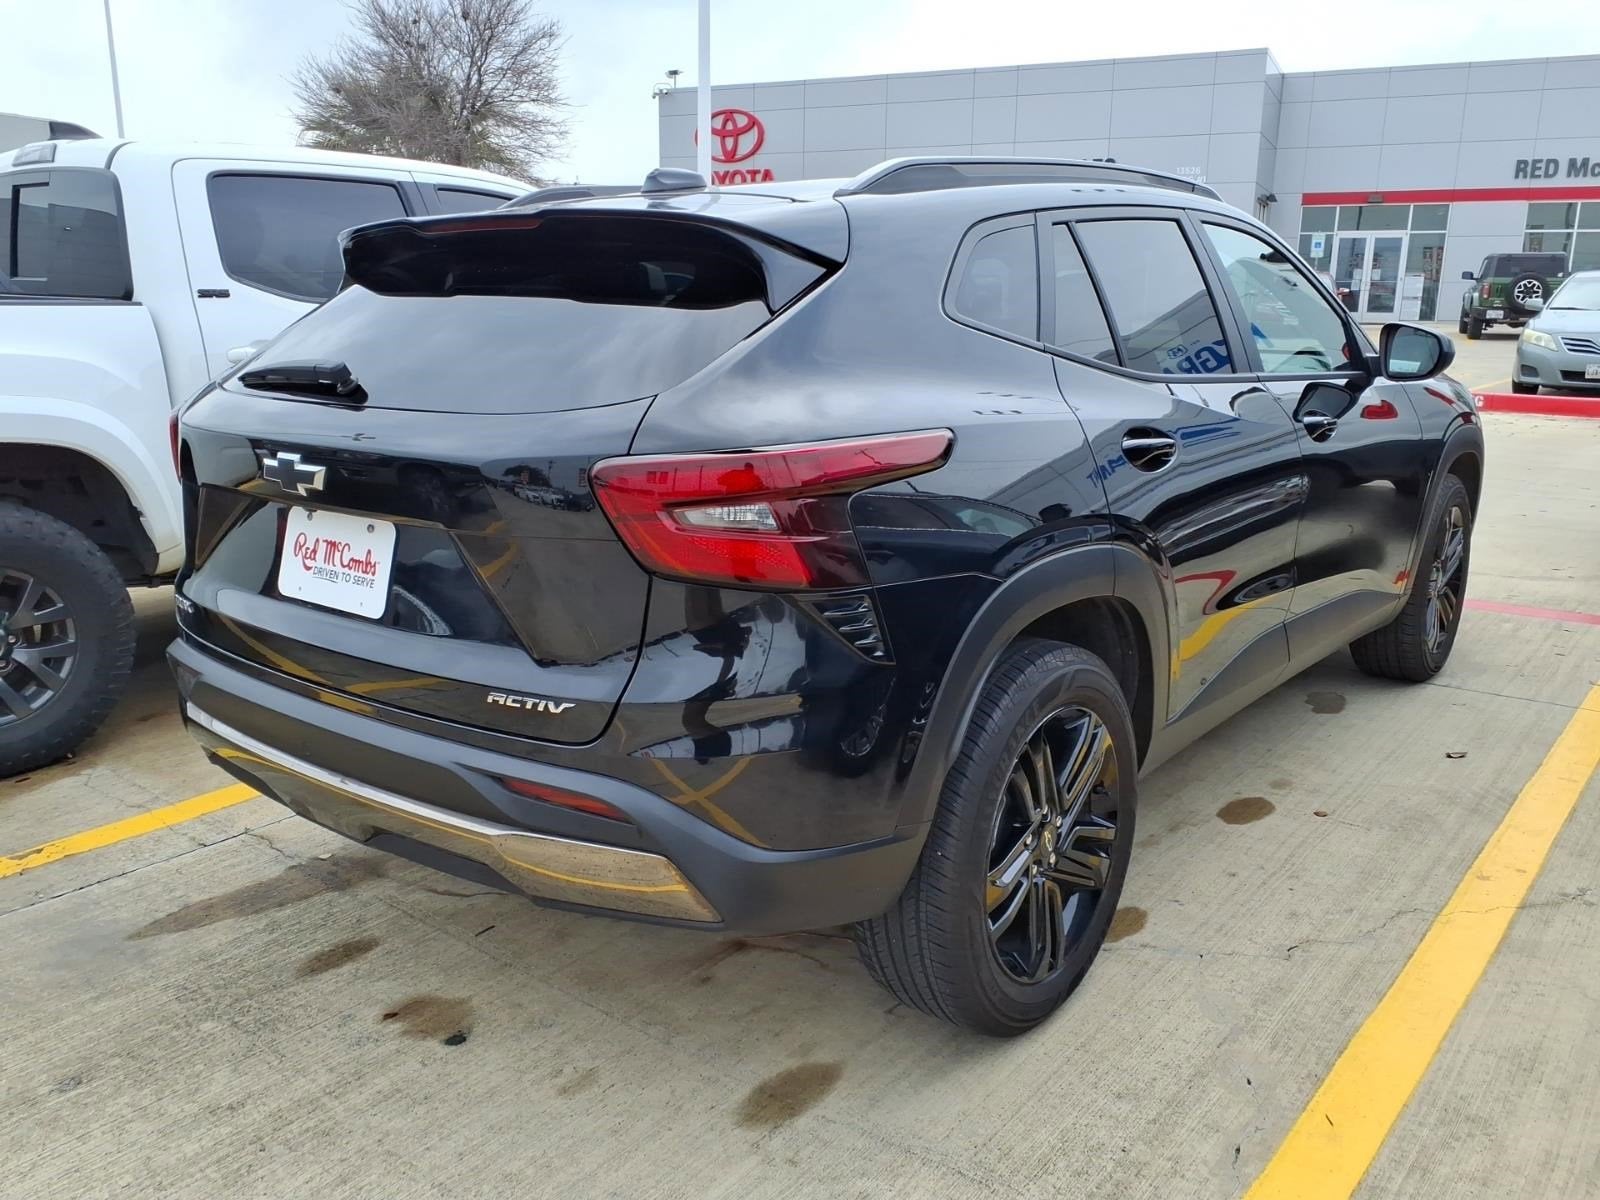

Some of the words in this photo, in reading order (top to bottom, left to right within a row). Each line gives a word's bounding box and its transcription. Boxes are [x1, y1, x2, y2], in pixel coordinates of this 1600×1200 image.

[1514, 158, 1560, 179] RED
[294, 532, 320, 571] Red
[322, 538, 377, 577] McCombs
[312, 566, 340, 581] DRIVEN
[341, 571, 352, 584] TO
[352, 574, 376, 589] SERVE
[487, 692, 577, 714] ACTIV
